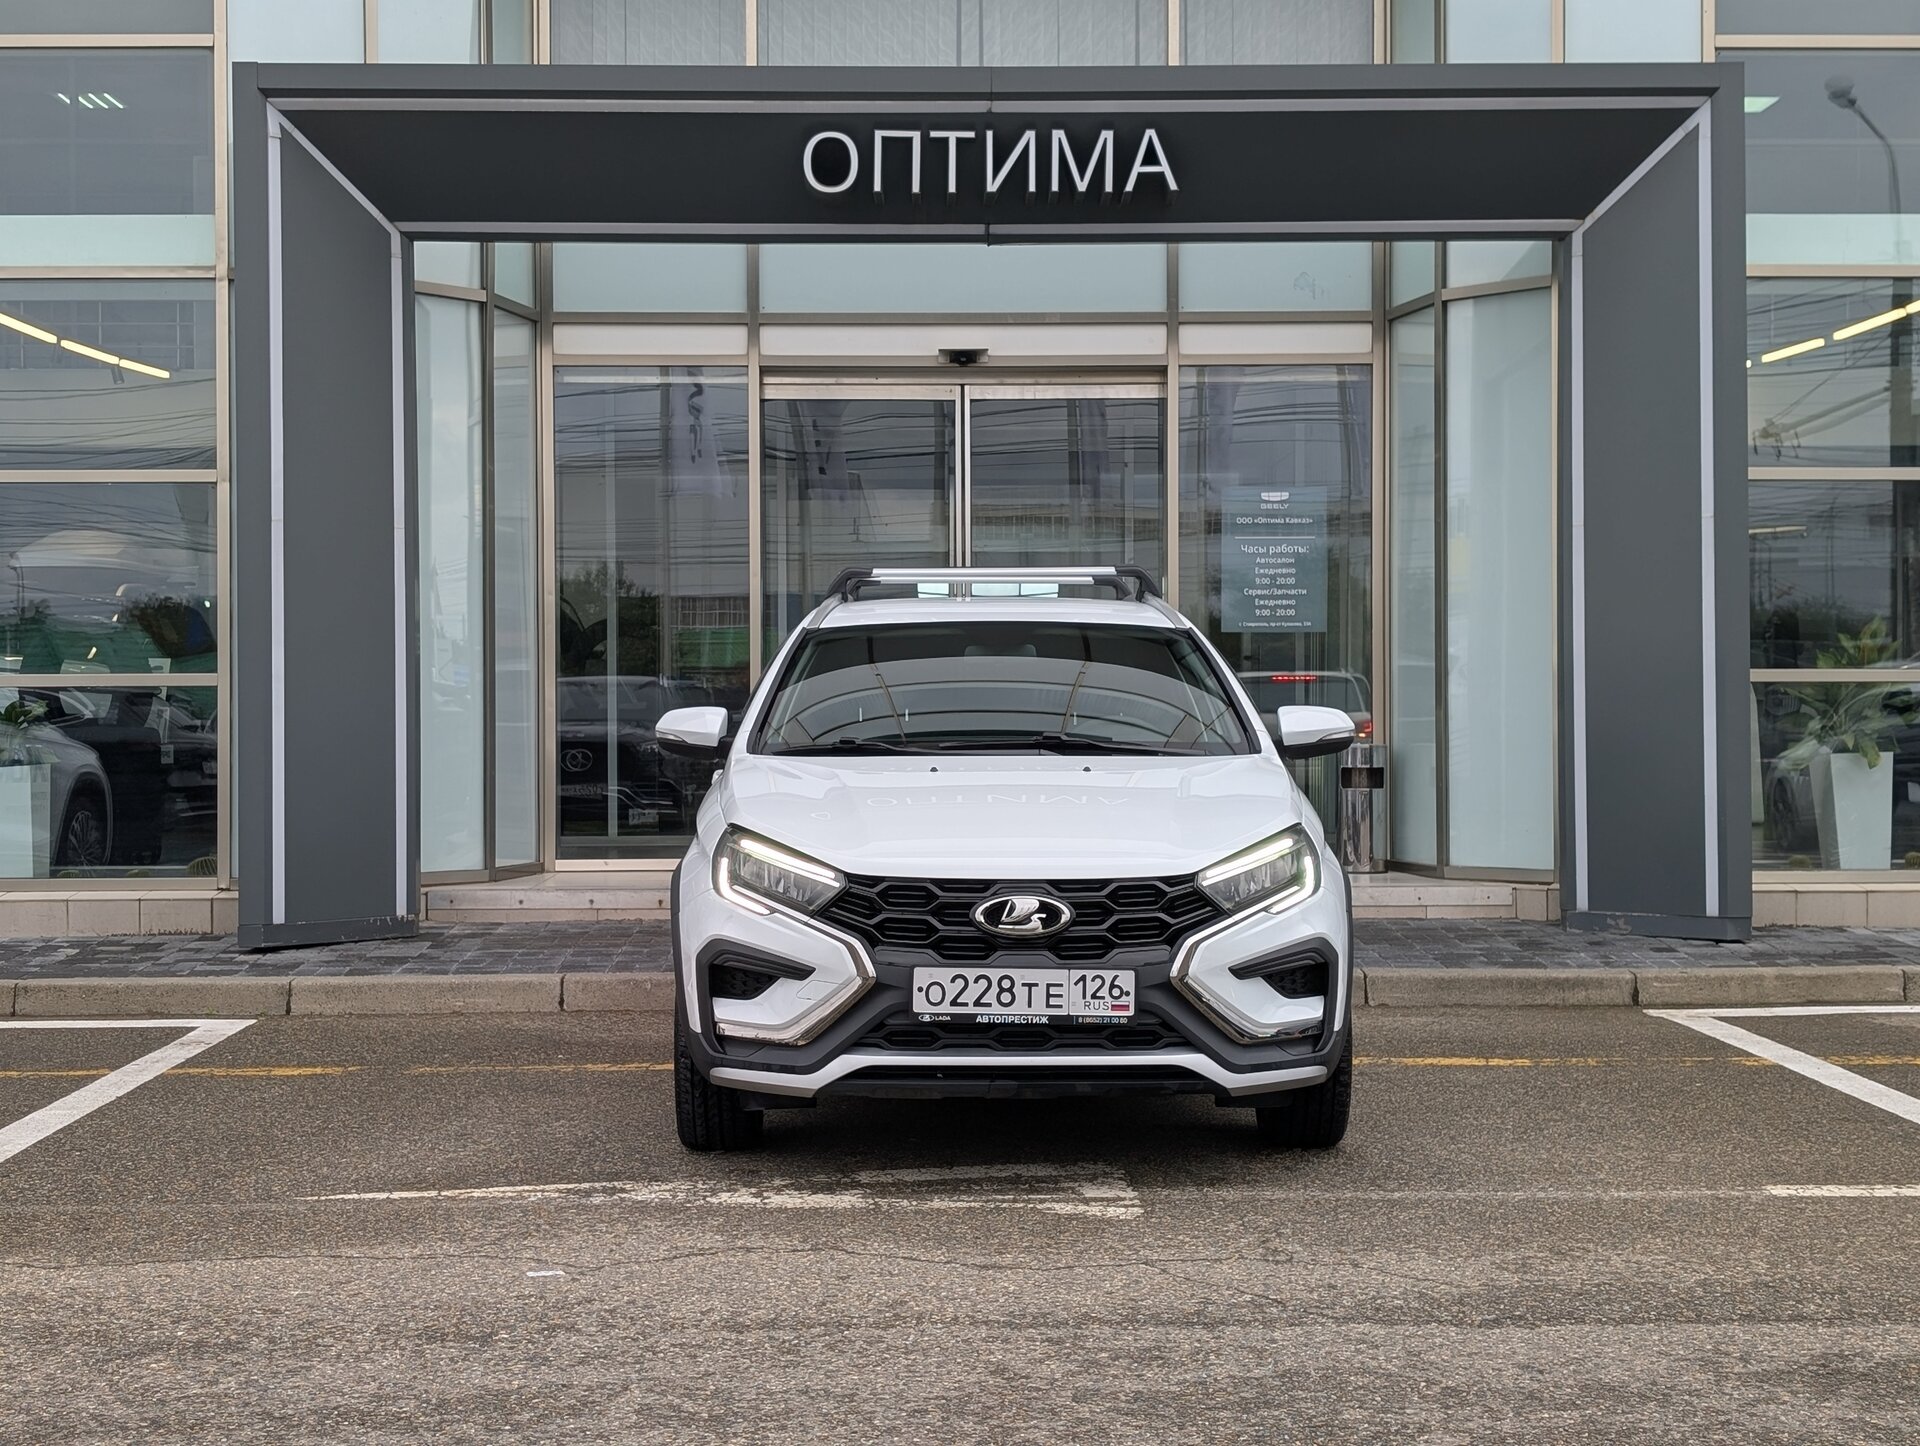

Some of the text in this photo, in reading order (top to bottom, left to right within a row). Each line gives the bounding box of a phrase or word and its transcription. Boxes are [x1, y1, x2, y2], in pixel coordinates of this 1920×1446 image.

[803, 129, 1180, 193] ОПТИМА
[1241, 544, 1310, 555] Часы работы:
[1255, 567, 1297, 575] Ежедневно
[1255, 577, 1271, 585] 9:00
[1276, 577, 1296, 585] 20:00
[1243, 588, 1307, 597] Сервис/Запчасти
[1255, 598, 1297, 606] Ежедневно
[925, 974, 1125, 1009] О228ТЕ 126
[1083, 1001, 1110, 1011] RUS
[975, 1014, 1049, 1024] АВТОПРЕСТИЖ
